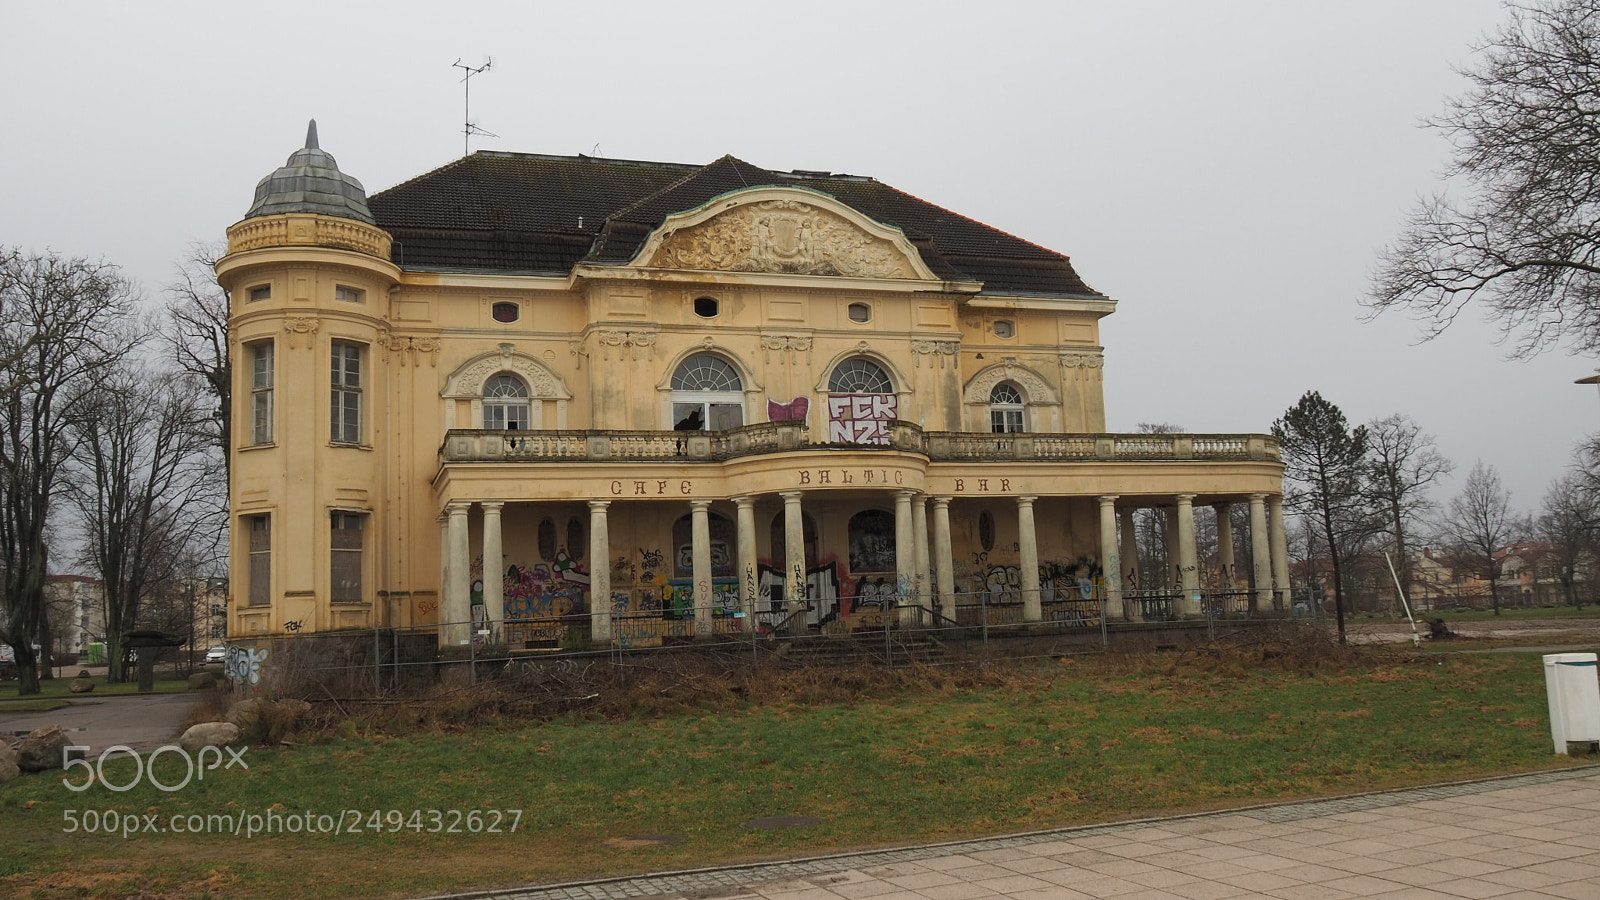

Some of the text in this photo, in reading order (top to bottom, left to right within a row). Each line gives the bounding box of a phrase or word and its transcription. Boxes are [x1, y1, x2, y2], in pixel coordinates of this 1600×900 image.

[829, 394, 898, 420] FCK
[798, 469, 903, 486] BALTIC
[954, 478, 1013, 492] BAR
[611, 480, 692, 495] CAFE
